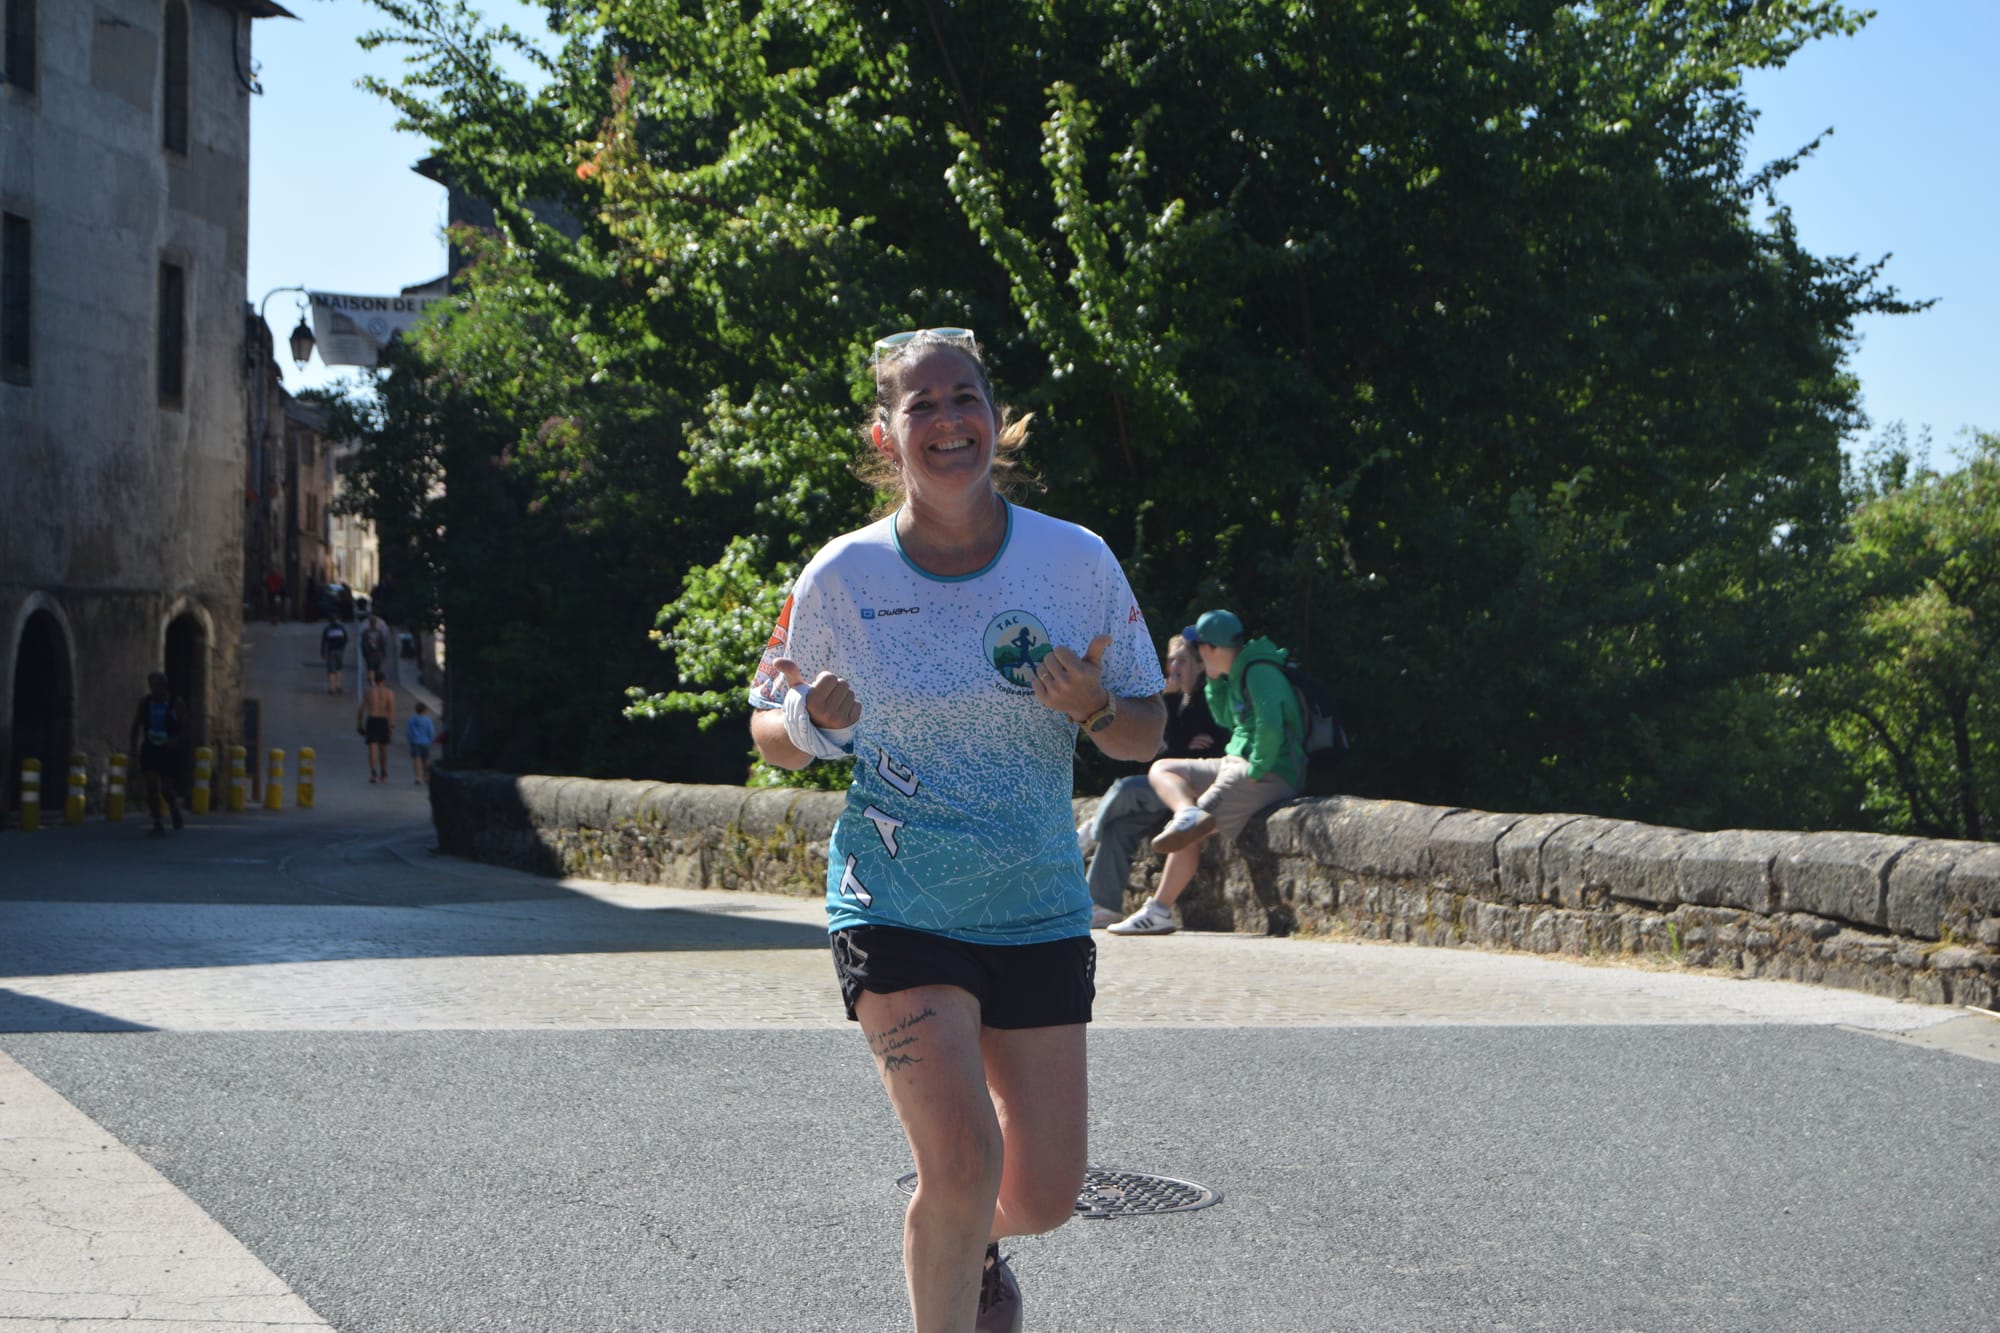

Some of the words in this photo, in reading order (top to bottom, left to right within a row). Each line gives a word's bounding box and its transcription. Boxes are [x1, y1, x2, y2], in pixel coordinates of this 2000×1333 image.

[315, 294, 387, 312] MAISON
[393, 298, 415, 312] DE
[996, 615, 1019, 631] TAC
